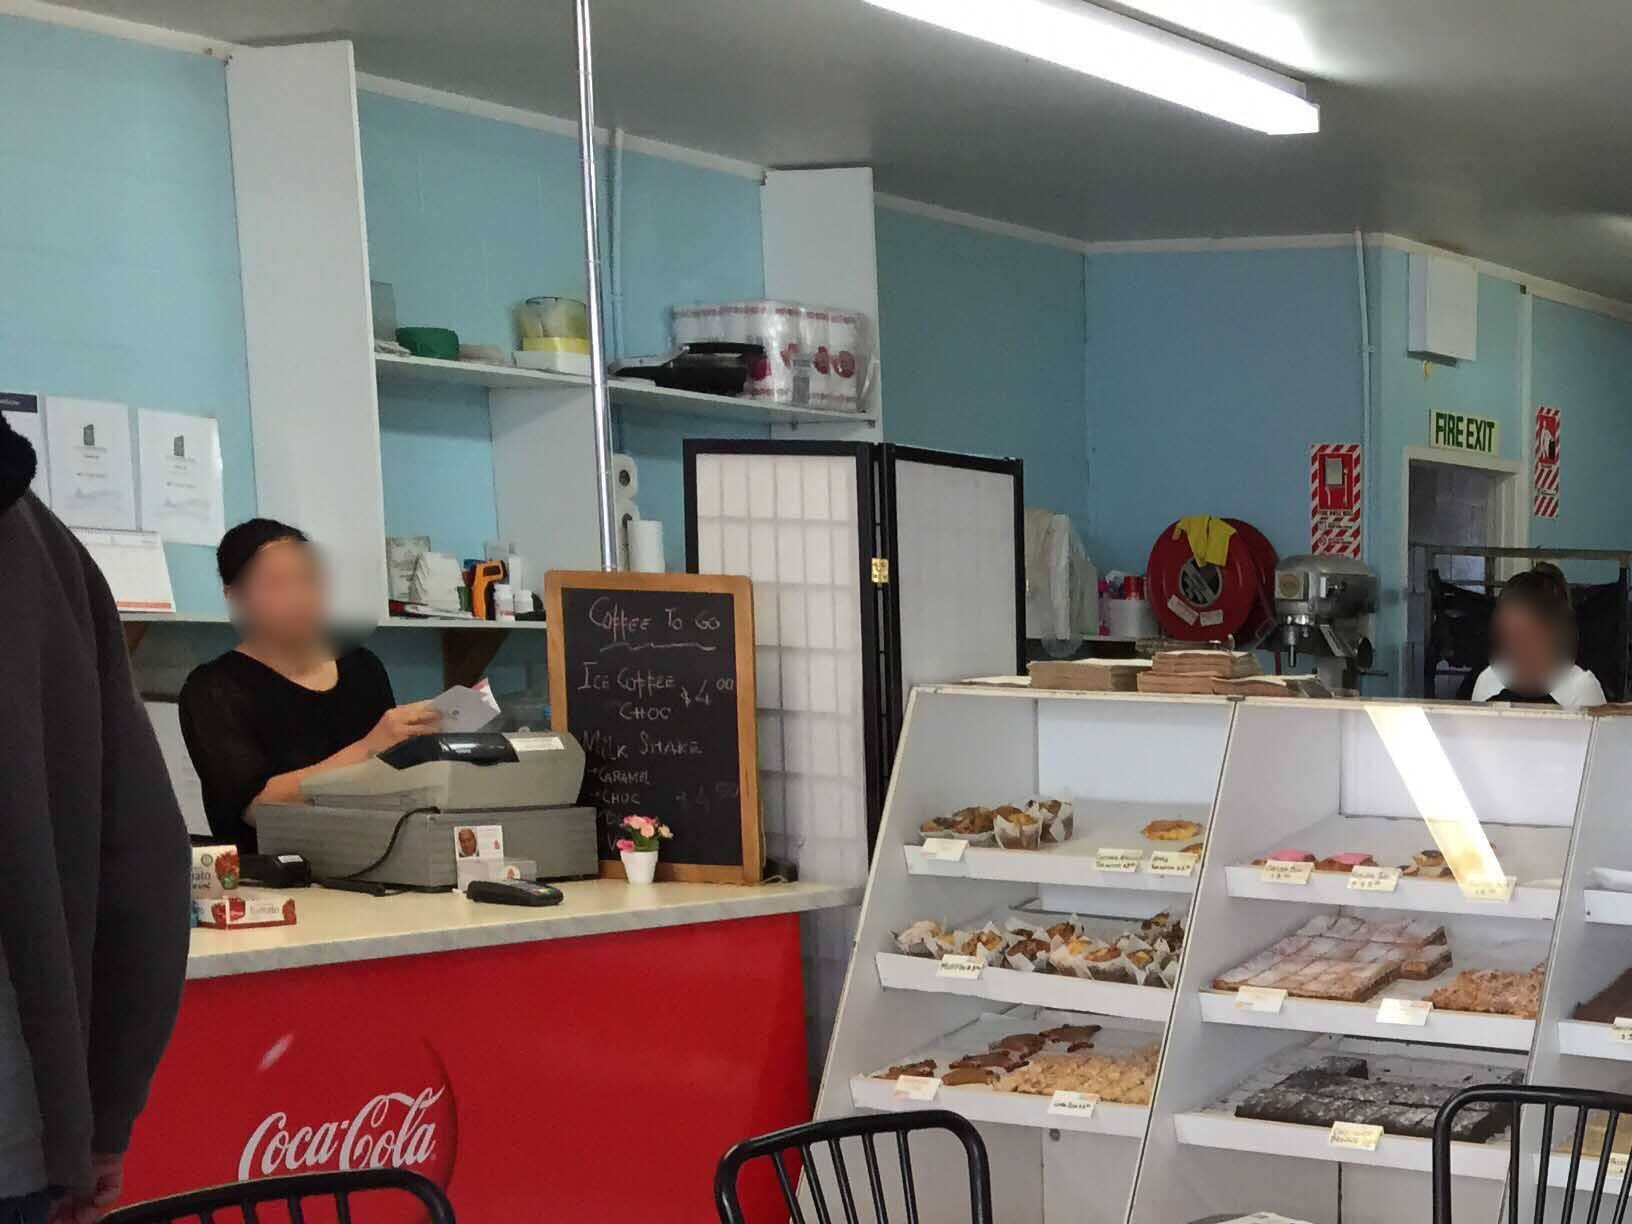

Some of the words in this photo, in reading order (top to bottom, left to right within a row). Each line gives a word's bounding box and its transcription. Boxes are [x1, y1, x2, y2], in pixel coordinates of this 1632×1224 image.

[1435, 411, 1464, 448] FIRE
[1466, 417, 1495, 453] EXIT
[238, 1085, 445, 1182] Coca-Cola
